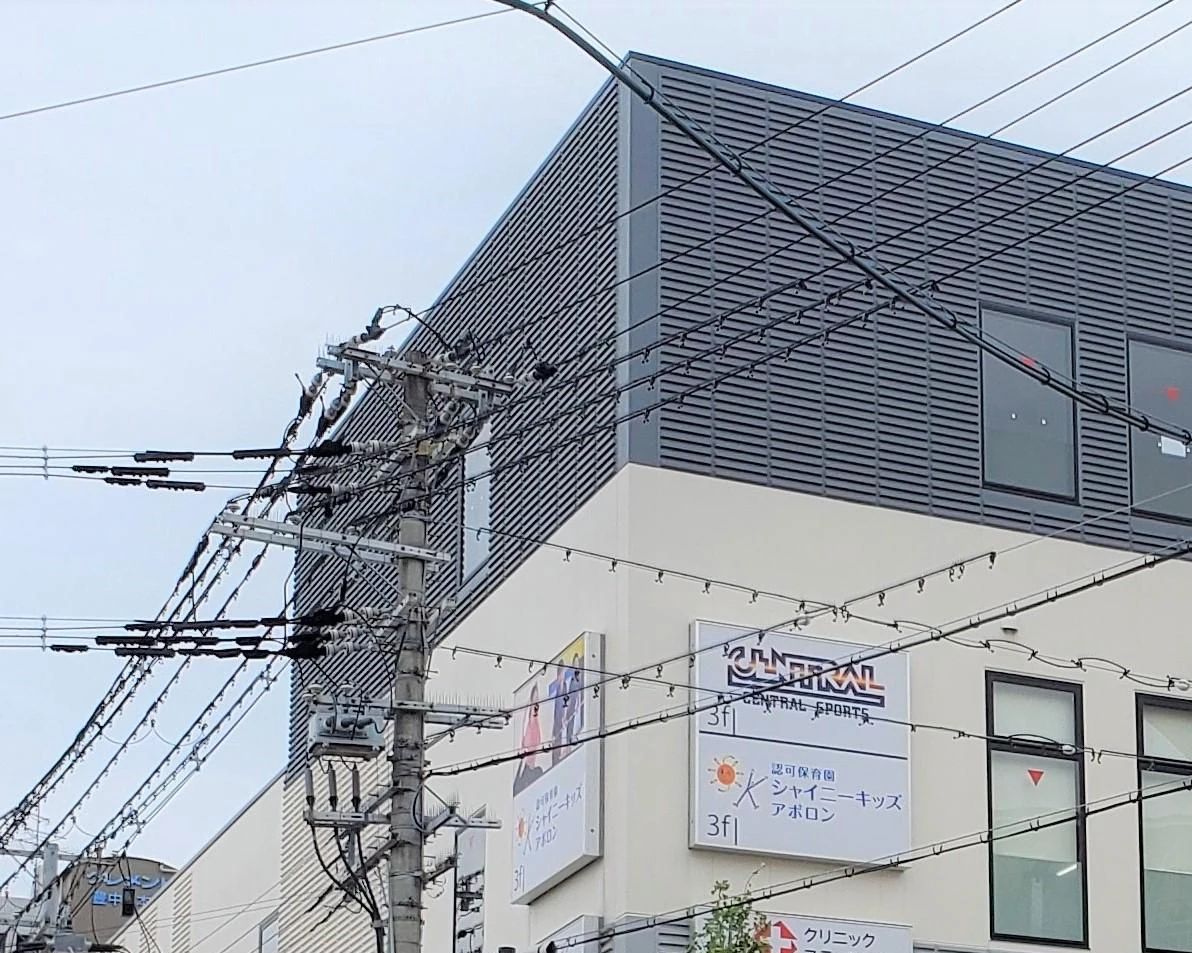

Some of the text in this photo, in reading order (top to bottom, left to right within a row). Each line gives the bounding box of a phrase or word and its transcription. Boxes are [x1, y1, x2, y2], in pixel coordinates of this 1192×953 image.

[728, 645, 885, 707] CENTRAL
[743, 691, 870, 720] CENTRAL SPORTS
[771, 762, 835, 782] 認可保育園
[771, 779, 902, 811] シャイニーキッズ
[771, 803, 835, 822] アポロン
[803, 927, 876, 948] クリニック
